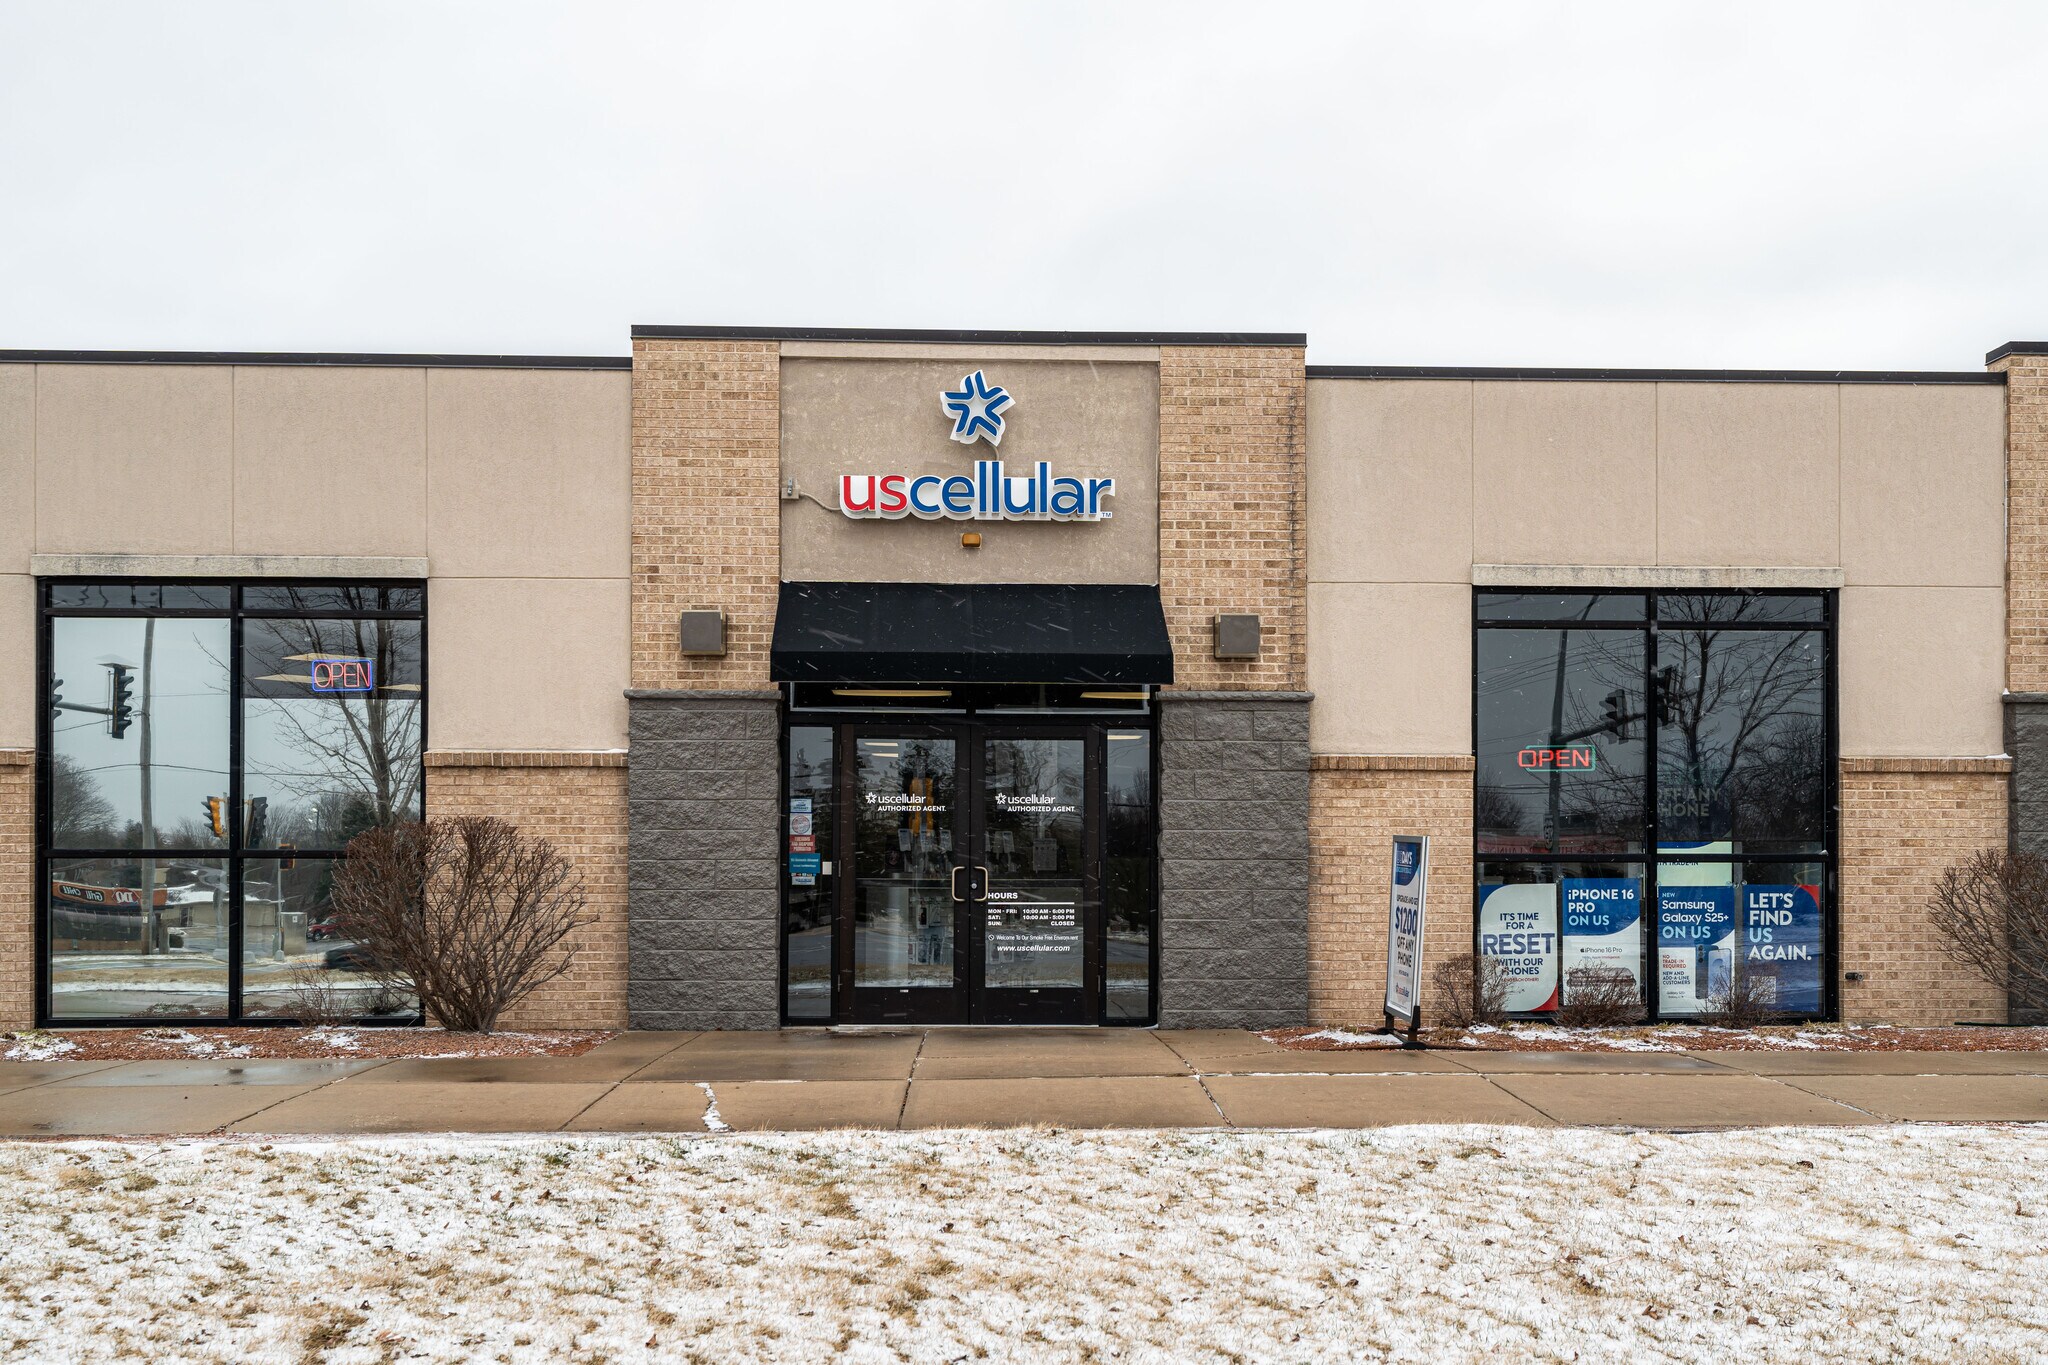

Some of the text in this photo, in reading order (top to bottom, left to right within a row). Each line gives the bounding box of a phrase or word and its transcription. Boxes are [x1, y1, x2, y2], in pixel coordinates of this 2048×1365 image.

[842, 461, 1112, 515] uscellular
[314, 663, 371, 688] OPEN
[1518, 749, 1590, 767] OPEN
[878, 793, 926, 804] uscellular
[1007, 794, 1056, 804] uscellular
[1657, 803, 1710, 817] HONE
[1568, 888, 1634, 900] iPHONE 16
[1662, 900, 1715, 912] Samsung
[1749, 892, 1794, 909] LET'S
[1568, 902, 1595, 913] PRO
[1395, 906, 1417, 937] $1200
[1500, 912, 1539, 921] IT'S TIME
[1568, 915, 1610, 926] ON US
[1662, 913, 1729, 925] Galaxy S25+
[1749, 910, 1793, 926] FIND
[1506, 922, 1534, 930] FOR A
[1662, 926, 1711, 939] ON US
[1749, 927, 1773, 943] US
[996, 944, 1071, 952] www.uscellular.com
[1482, 932, 1556, 955] RESET
[1585, 946, 1605, 954] iPhone
[1748, 945, 1812, 961] AGAIN.
[1523, 957, 1544, 966] OUR
